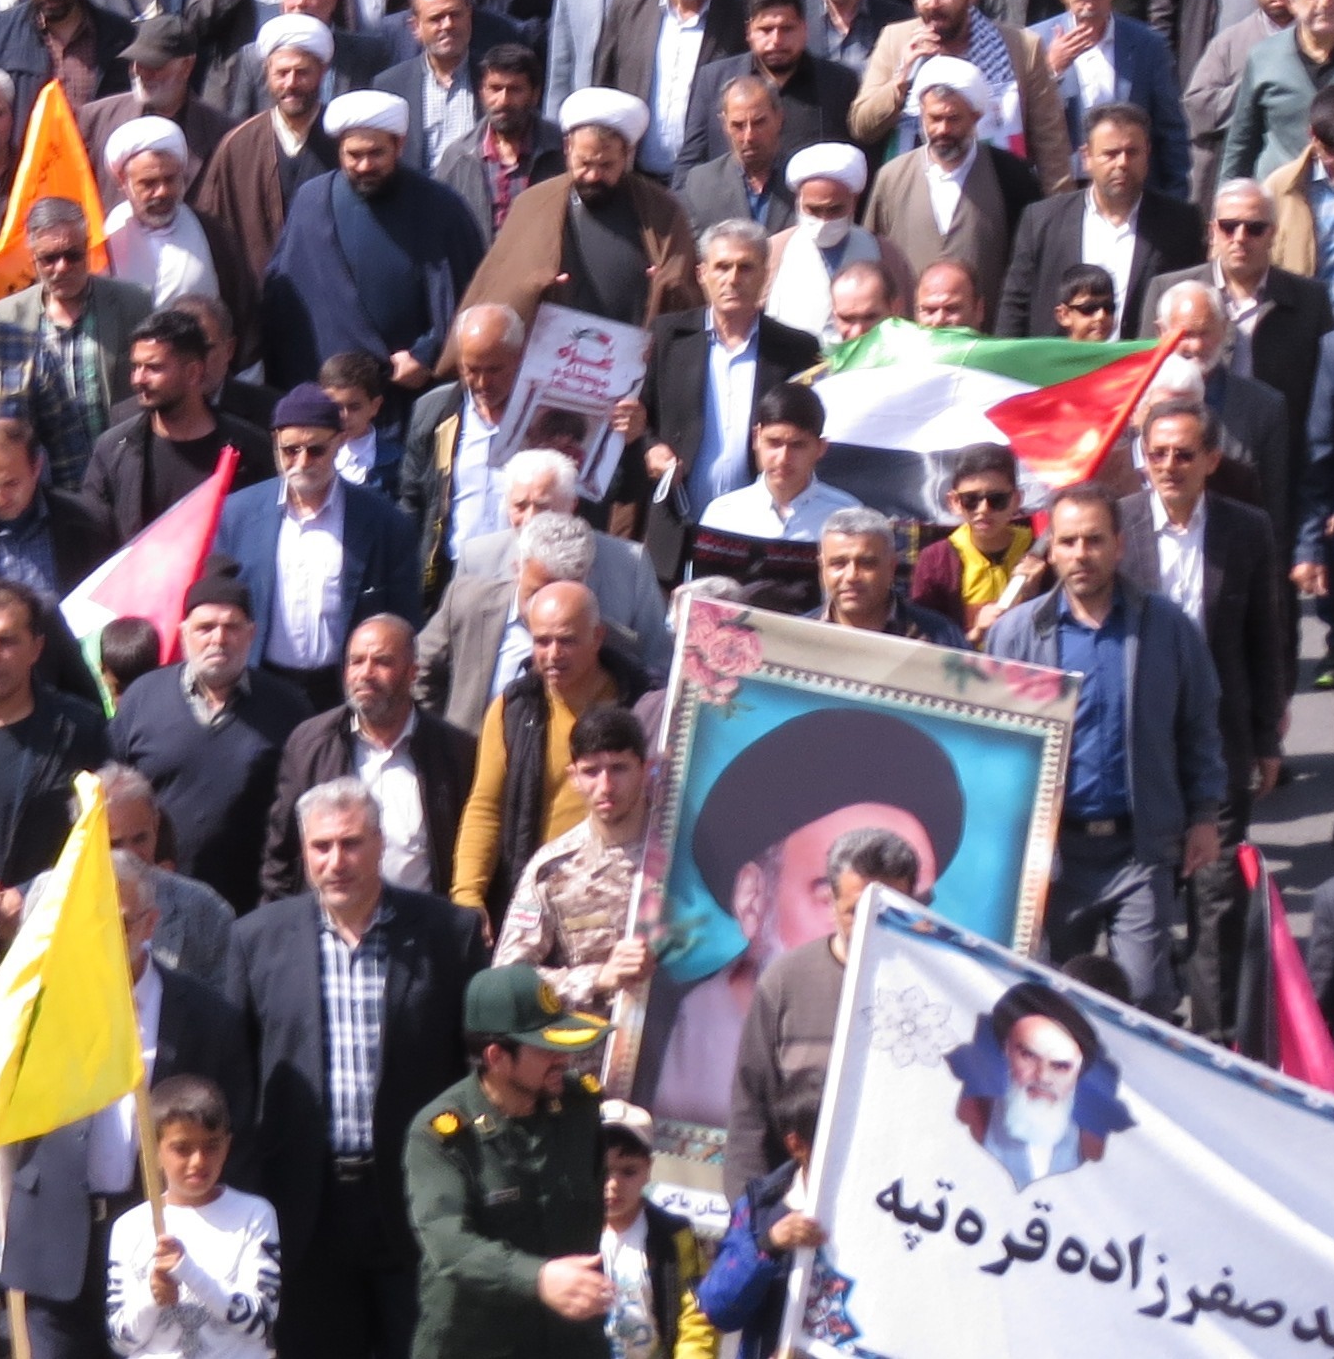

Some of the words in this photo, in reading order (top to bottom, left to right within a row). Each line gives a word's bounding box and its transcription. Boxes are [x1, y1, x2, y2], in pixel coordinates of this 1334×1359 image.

[661, 1190, 692, 1210] ماکو
[875, 1176, 955, 1251] تپه
[954, 1199, 1053, 1276] قره
